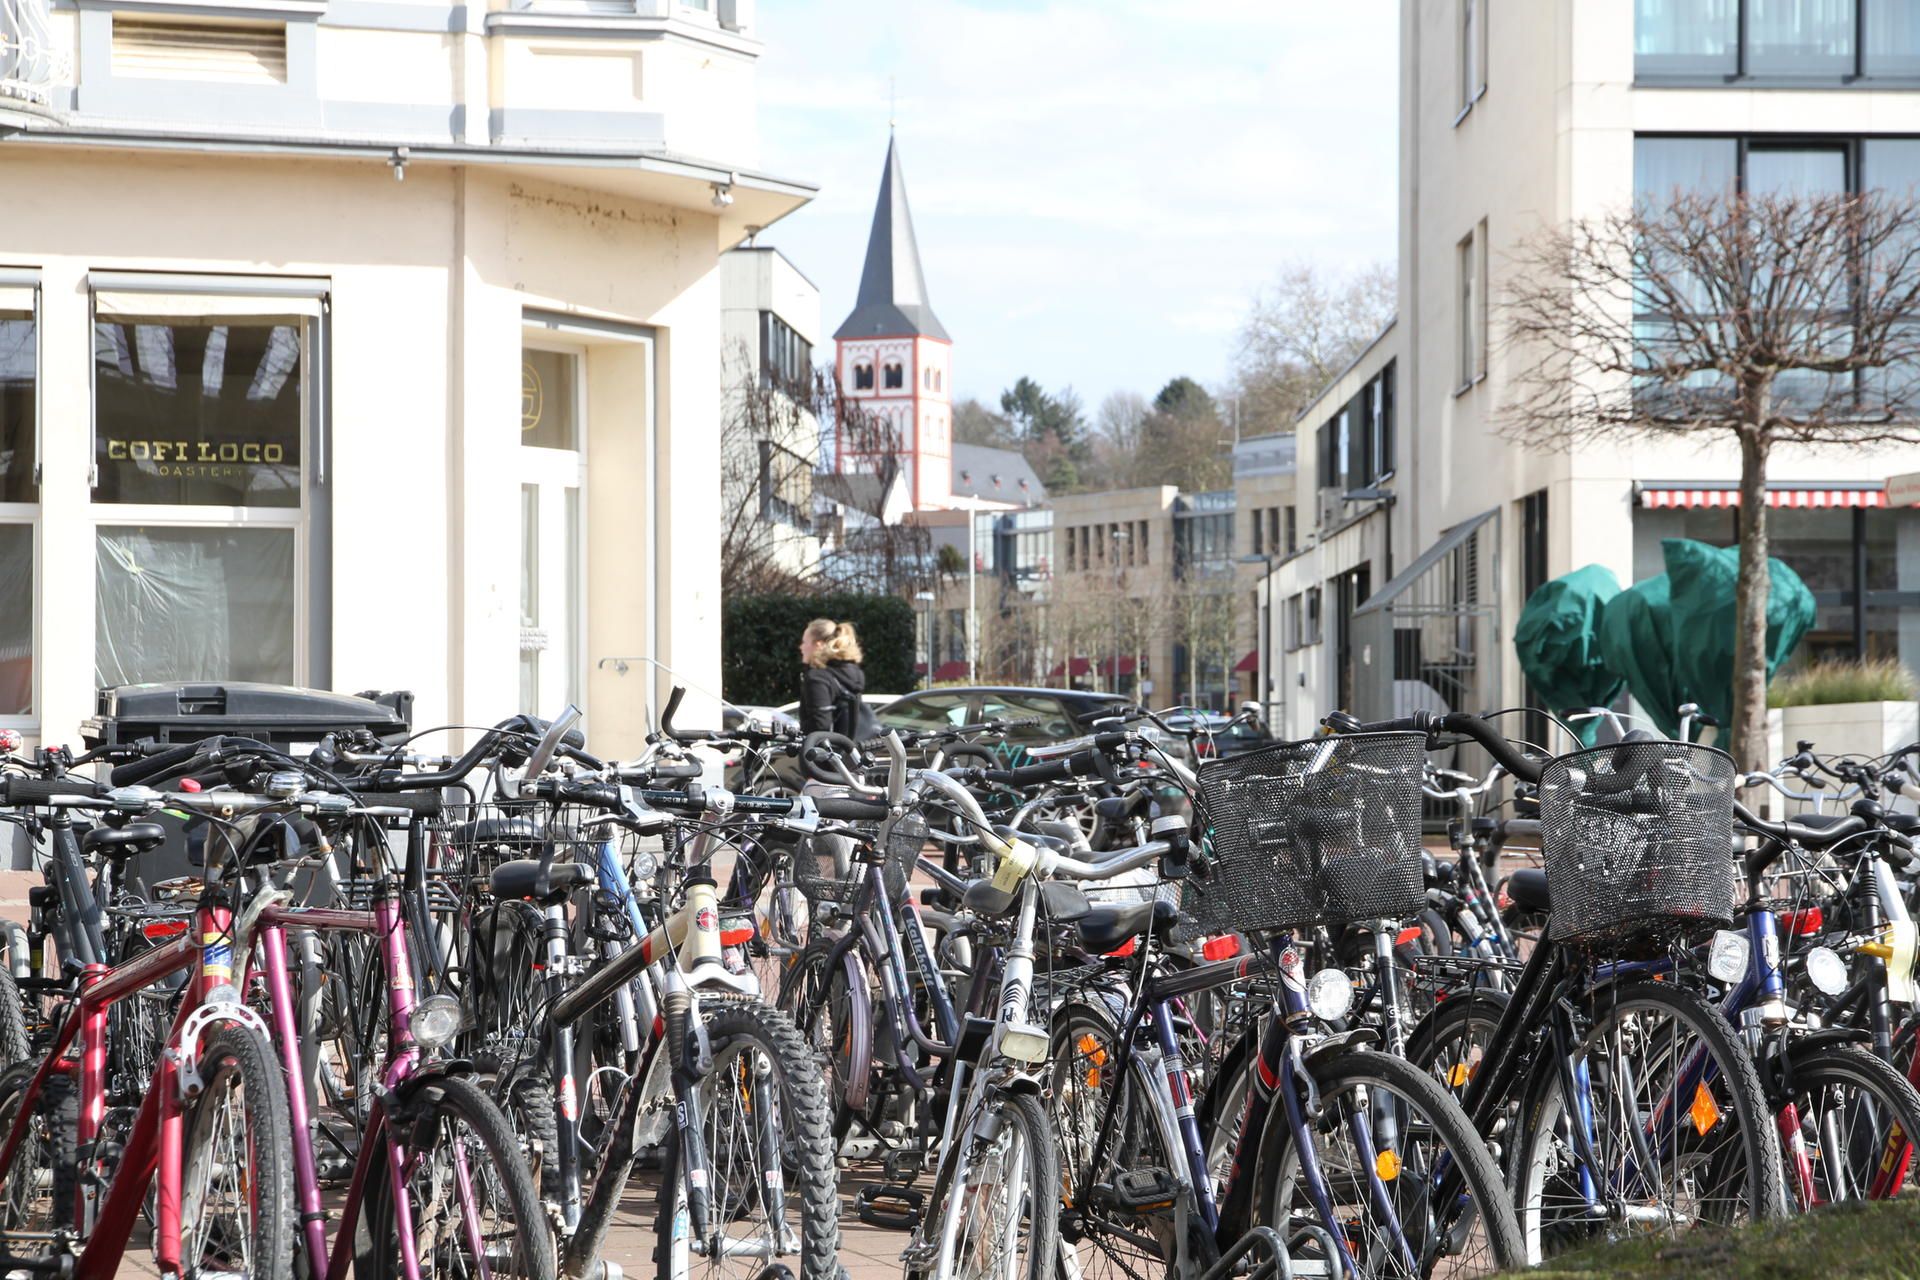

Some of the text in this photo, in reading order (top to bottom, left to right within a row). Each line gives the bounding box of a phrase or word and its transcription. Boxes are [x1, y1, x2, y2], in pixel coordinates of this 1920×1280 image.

[108, 440, 283, 462] COFI LOCO
[905, 917, 935, 986] Kalkhoff
